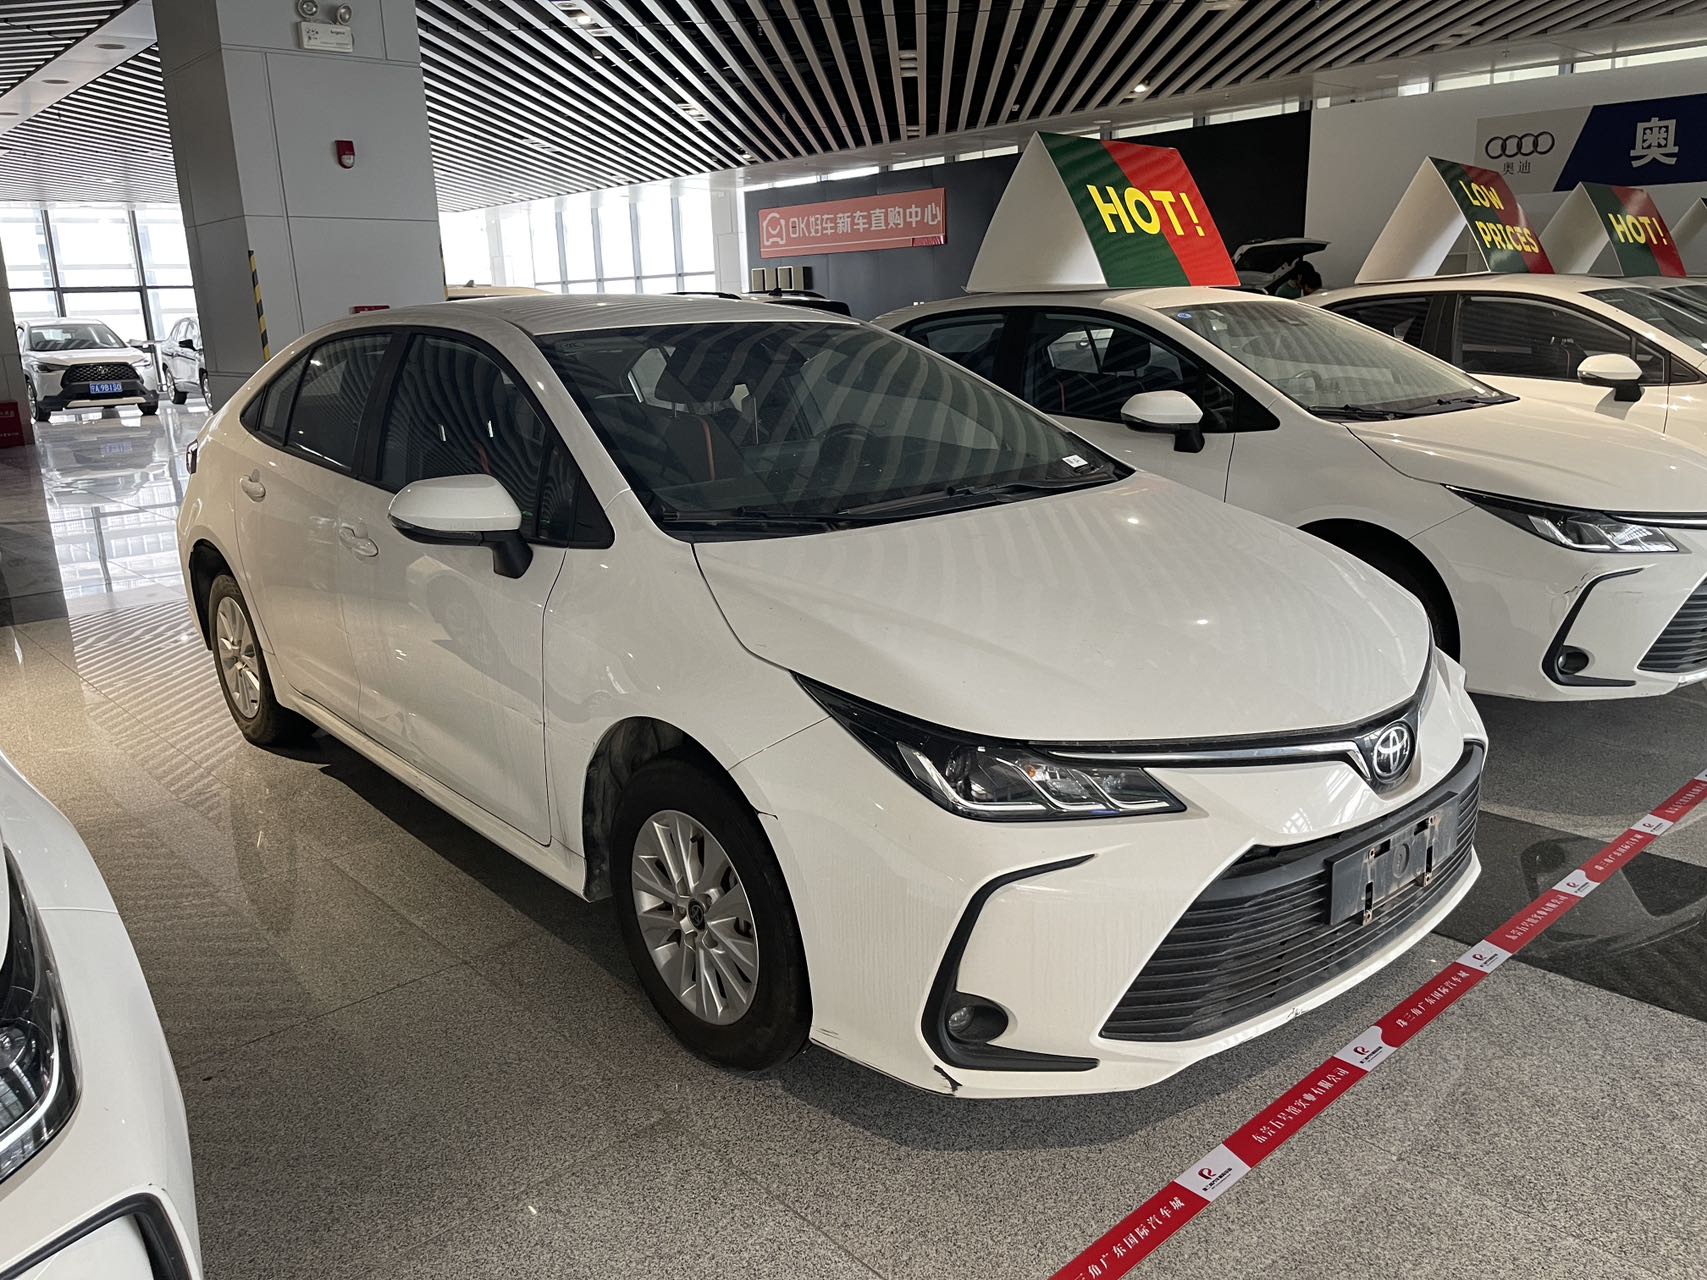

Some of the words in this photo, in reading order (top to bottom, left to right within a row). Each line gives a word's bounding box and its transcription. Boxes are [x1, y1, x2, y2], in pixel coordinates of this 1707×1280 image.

[1630, 117, 1679, 168] 奥
[1503, 160, 1531, 175] 奥迪
[1086, 184, 1206, 237] HOT!
[1458, 180, 1505, 210] LOW
[1474, 220, 1540, 254] PRICES
[1608, 213, 1668, 246] HOT!
